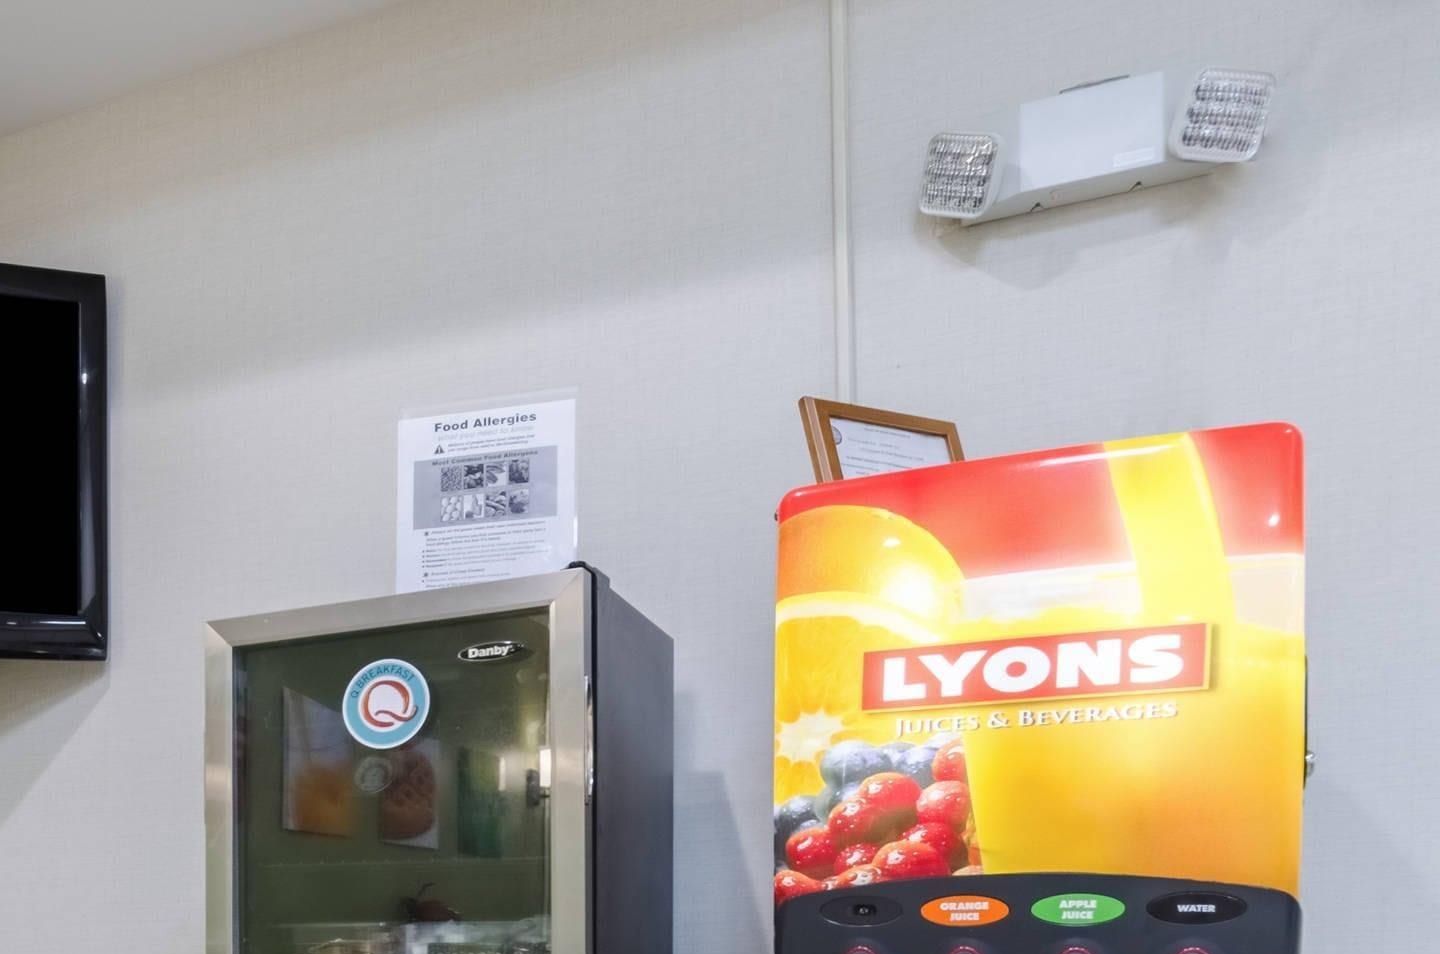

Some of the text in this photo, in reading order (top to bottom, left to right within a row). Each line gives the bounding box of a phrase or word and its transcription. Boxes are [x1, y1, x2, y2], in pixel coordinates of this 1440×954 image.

[434, 413, 537, 433] Food Allergies
[467, 645, 509, 659] Danby
[882, 634, 1184, 702] LYONS
[357, 664, 416, 689] BREAKFAST
[361, 679, 418, 728] Q
[896, 701, 1178, 737] JUICES & BEVERAGES
[939, 901, 990, 912] ORANGE
[1059, 898, 1097, 910] APPLE
[1176, 903, 1217, 914] WATER
[950, 911, 980, 922] JUICE
[1061, 910, 1094, 921] JUICE
